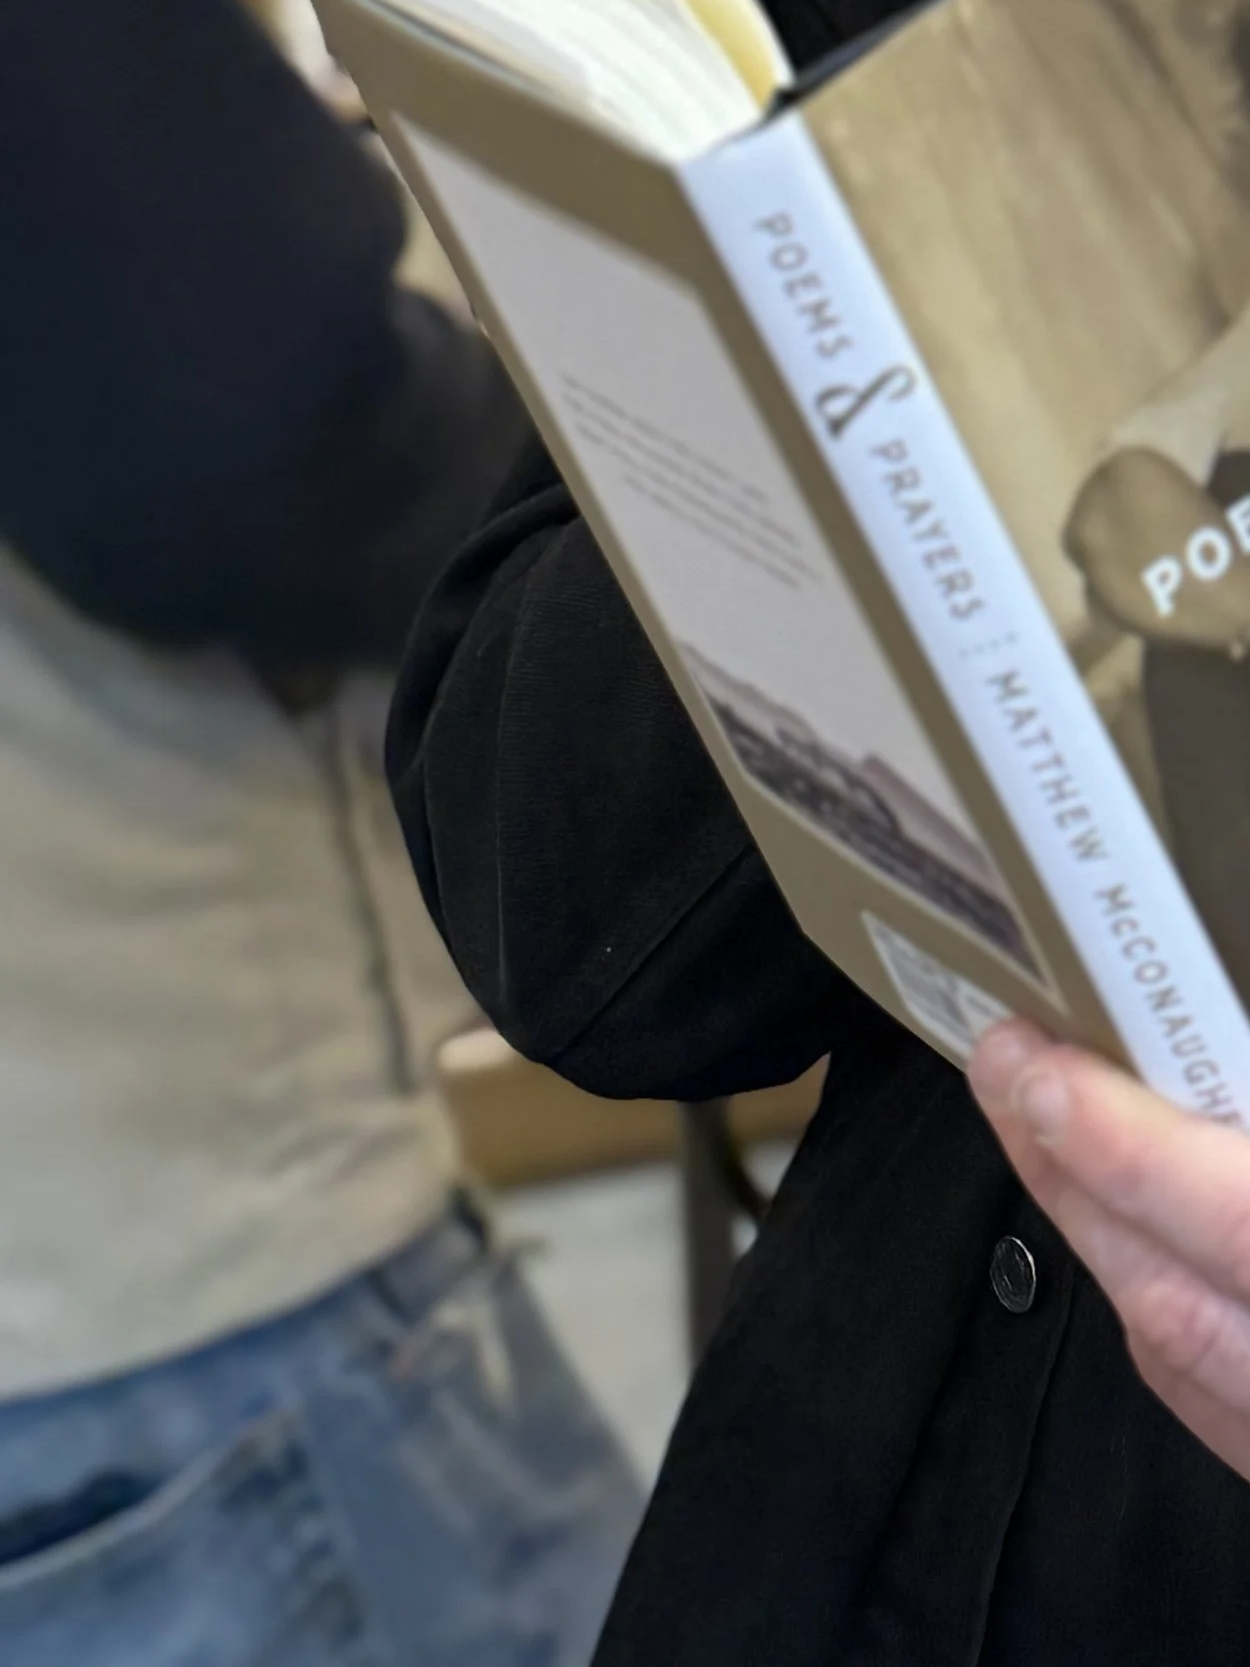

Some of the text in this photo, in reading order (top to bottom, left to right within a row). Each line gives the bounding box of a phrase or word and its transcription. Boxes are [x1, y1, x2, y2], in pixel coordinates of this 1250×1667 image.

[753, 211, 853, 360] POEMS
[814, 362, 919, 440] &
[871, 439, 984, 622] PRAYERS
[988, 669, 1109, 865] MATTHEW
